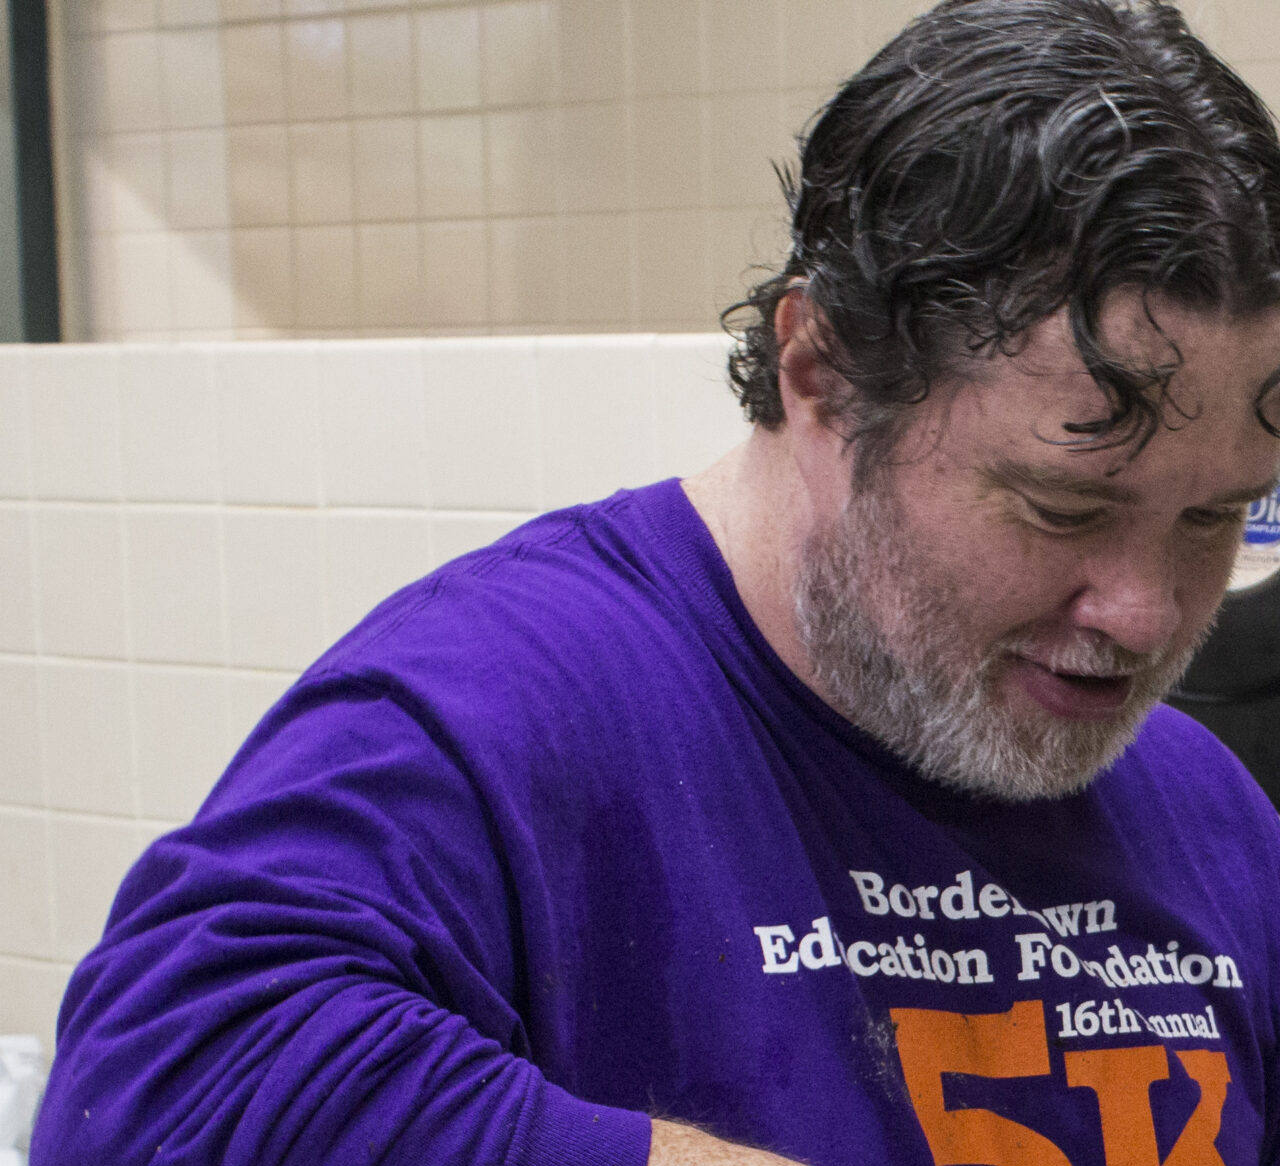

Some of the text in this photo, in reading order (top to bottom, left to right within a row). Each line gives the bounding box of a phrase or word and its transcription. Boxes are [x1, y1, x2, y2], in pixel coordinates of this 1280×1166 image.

[848, 869, 1118, 938] Bordewn
[753, 915, 995, 985] Edcation
[1055, 998, 1221, 1039] 16th nnual
